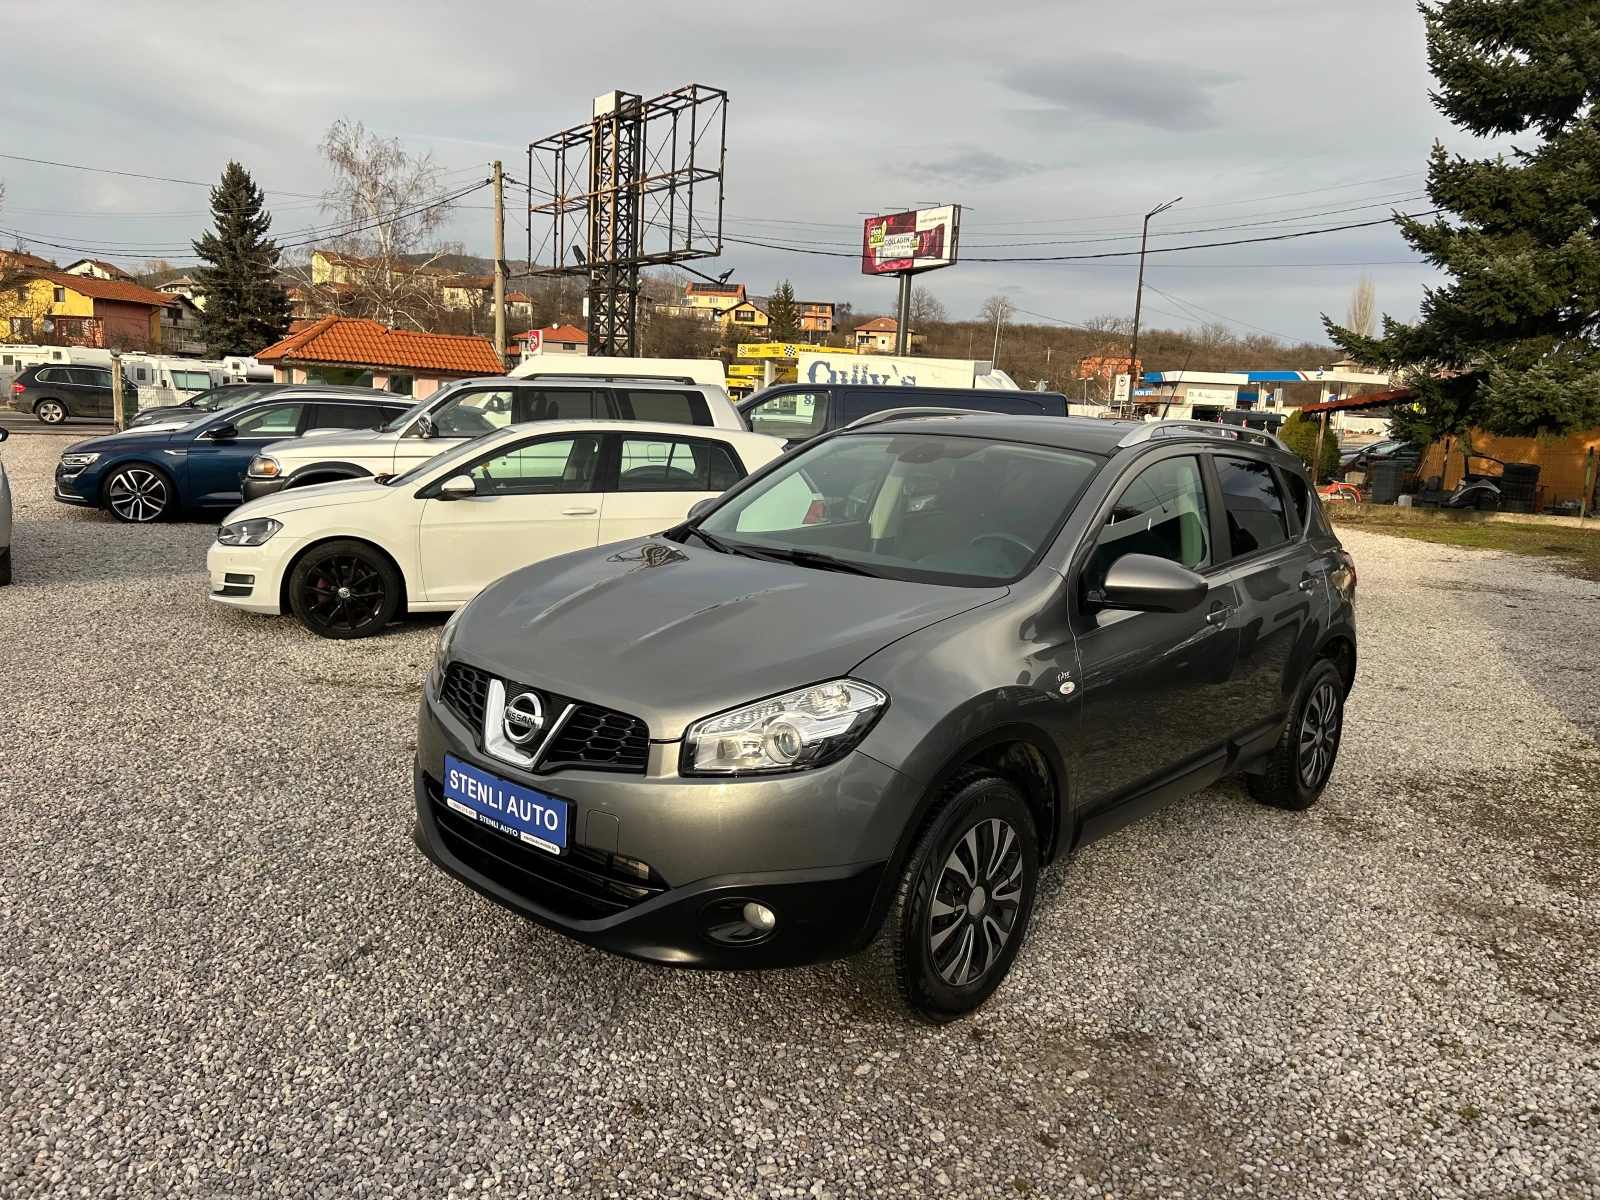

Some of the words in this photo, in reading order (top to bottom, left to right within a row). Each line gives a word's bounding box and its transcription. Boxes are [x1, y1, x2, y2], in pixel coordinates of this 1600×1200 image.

[505, 707, 536, 727] NISSAN
[450, 769, 503, 811] STENLI
[506, 795, 559, 831] AUTO
[479, 814, 499, 829] STENLI
[500, 823, 519, 837] AUTO
